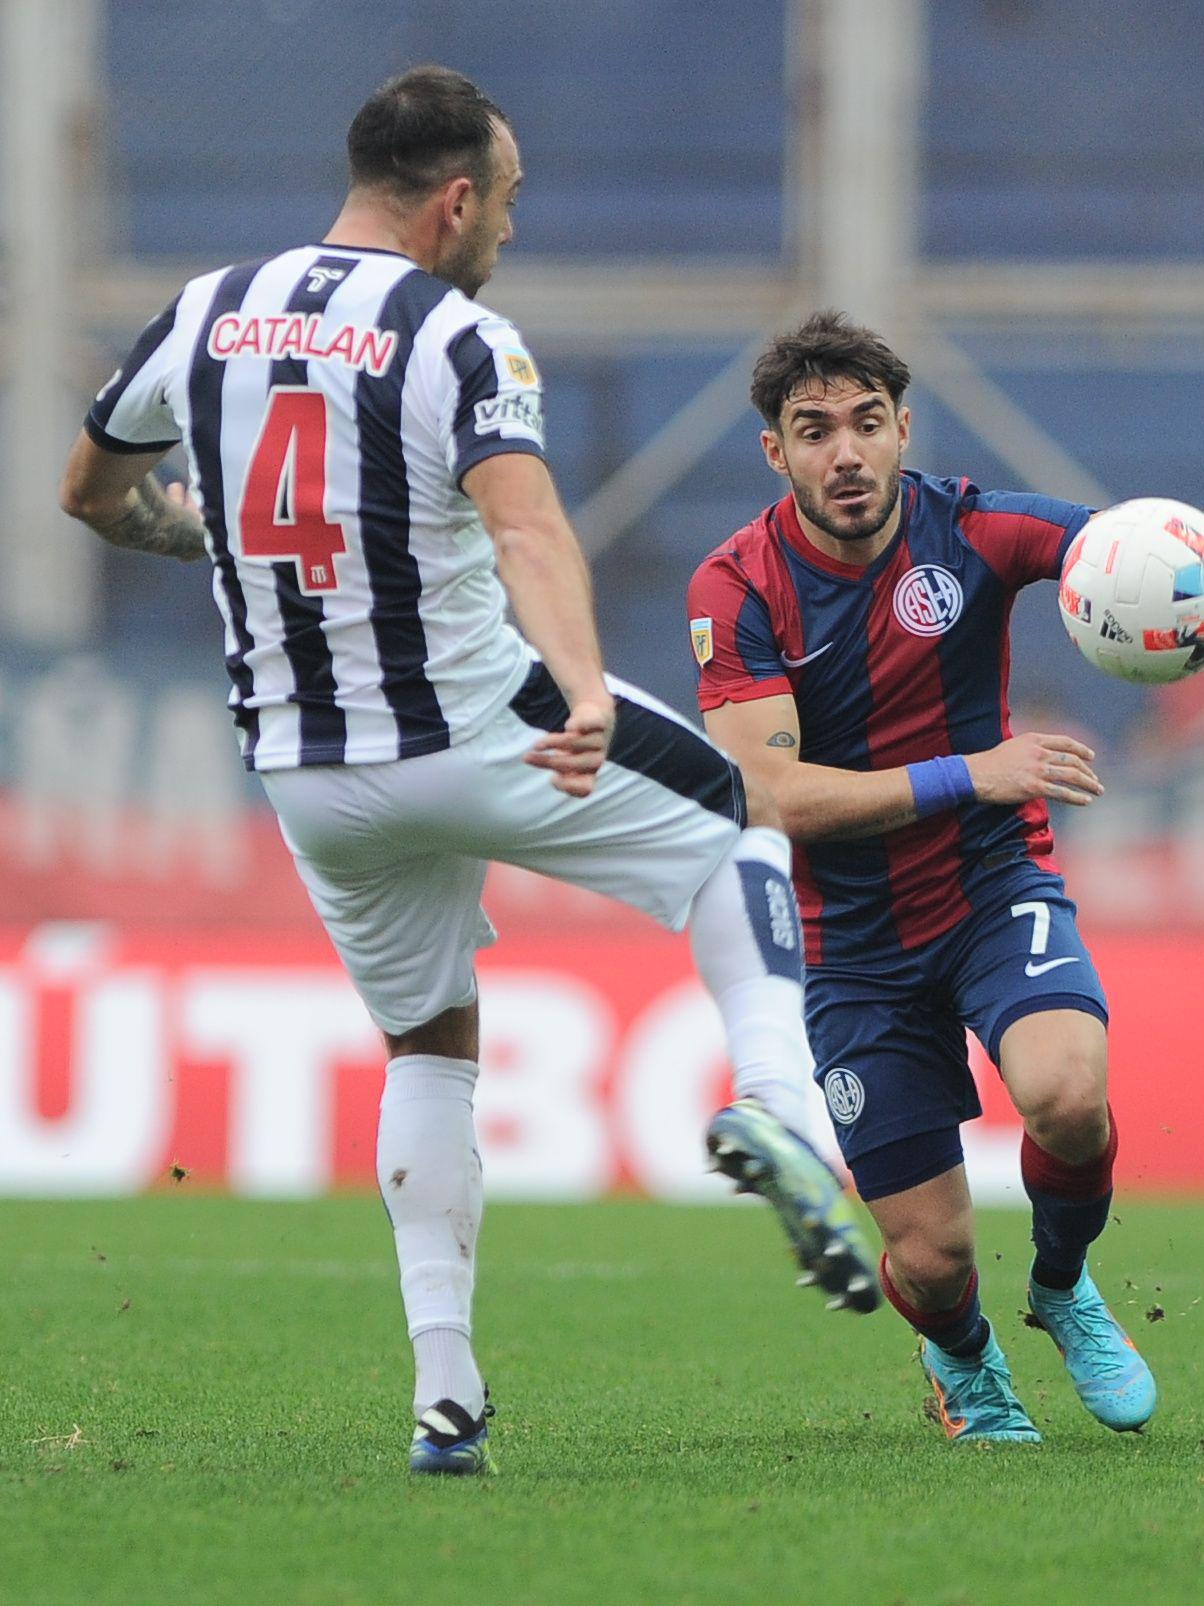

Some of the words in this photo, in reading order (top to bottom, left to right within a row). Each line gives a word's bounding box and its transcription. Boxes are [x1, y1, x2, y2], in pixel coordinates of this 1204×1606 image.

[210, 315, 395, 374] CATALAN
[240, 392, 346, 590] 4
[1010, 901, 1051, 955] 7
[0, 916, 1022, 1194] ÚTBO
